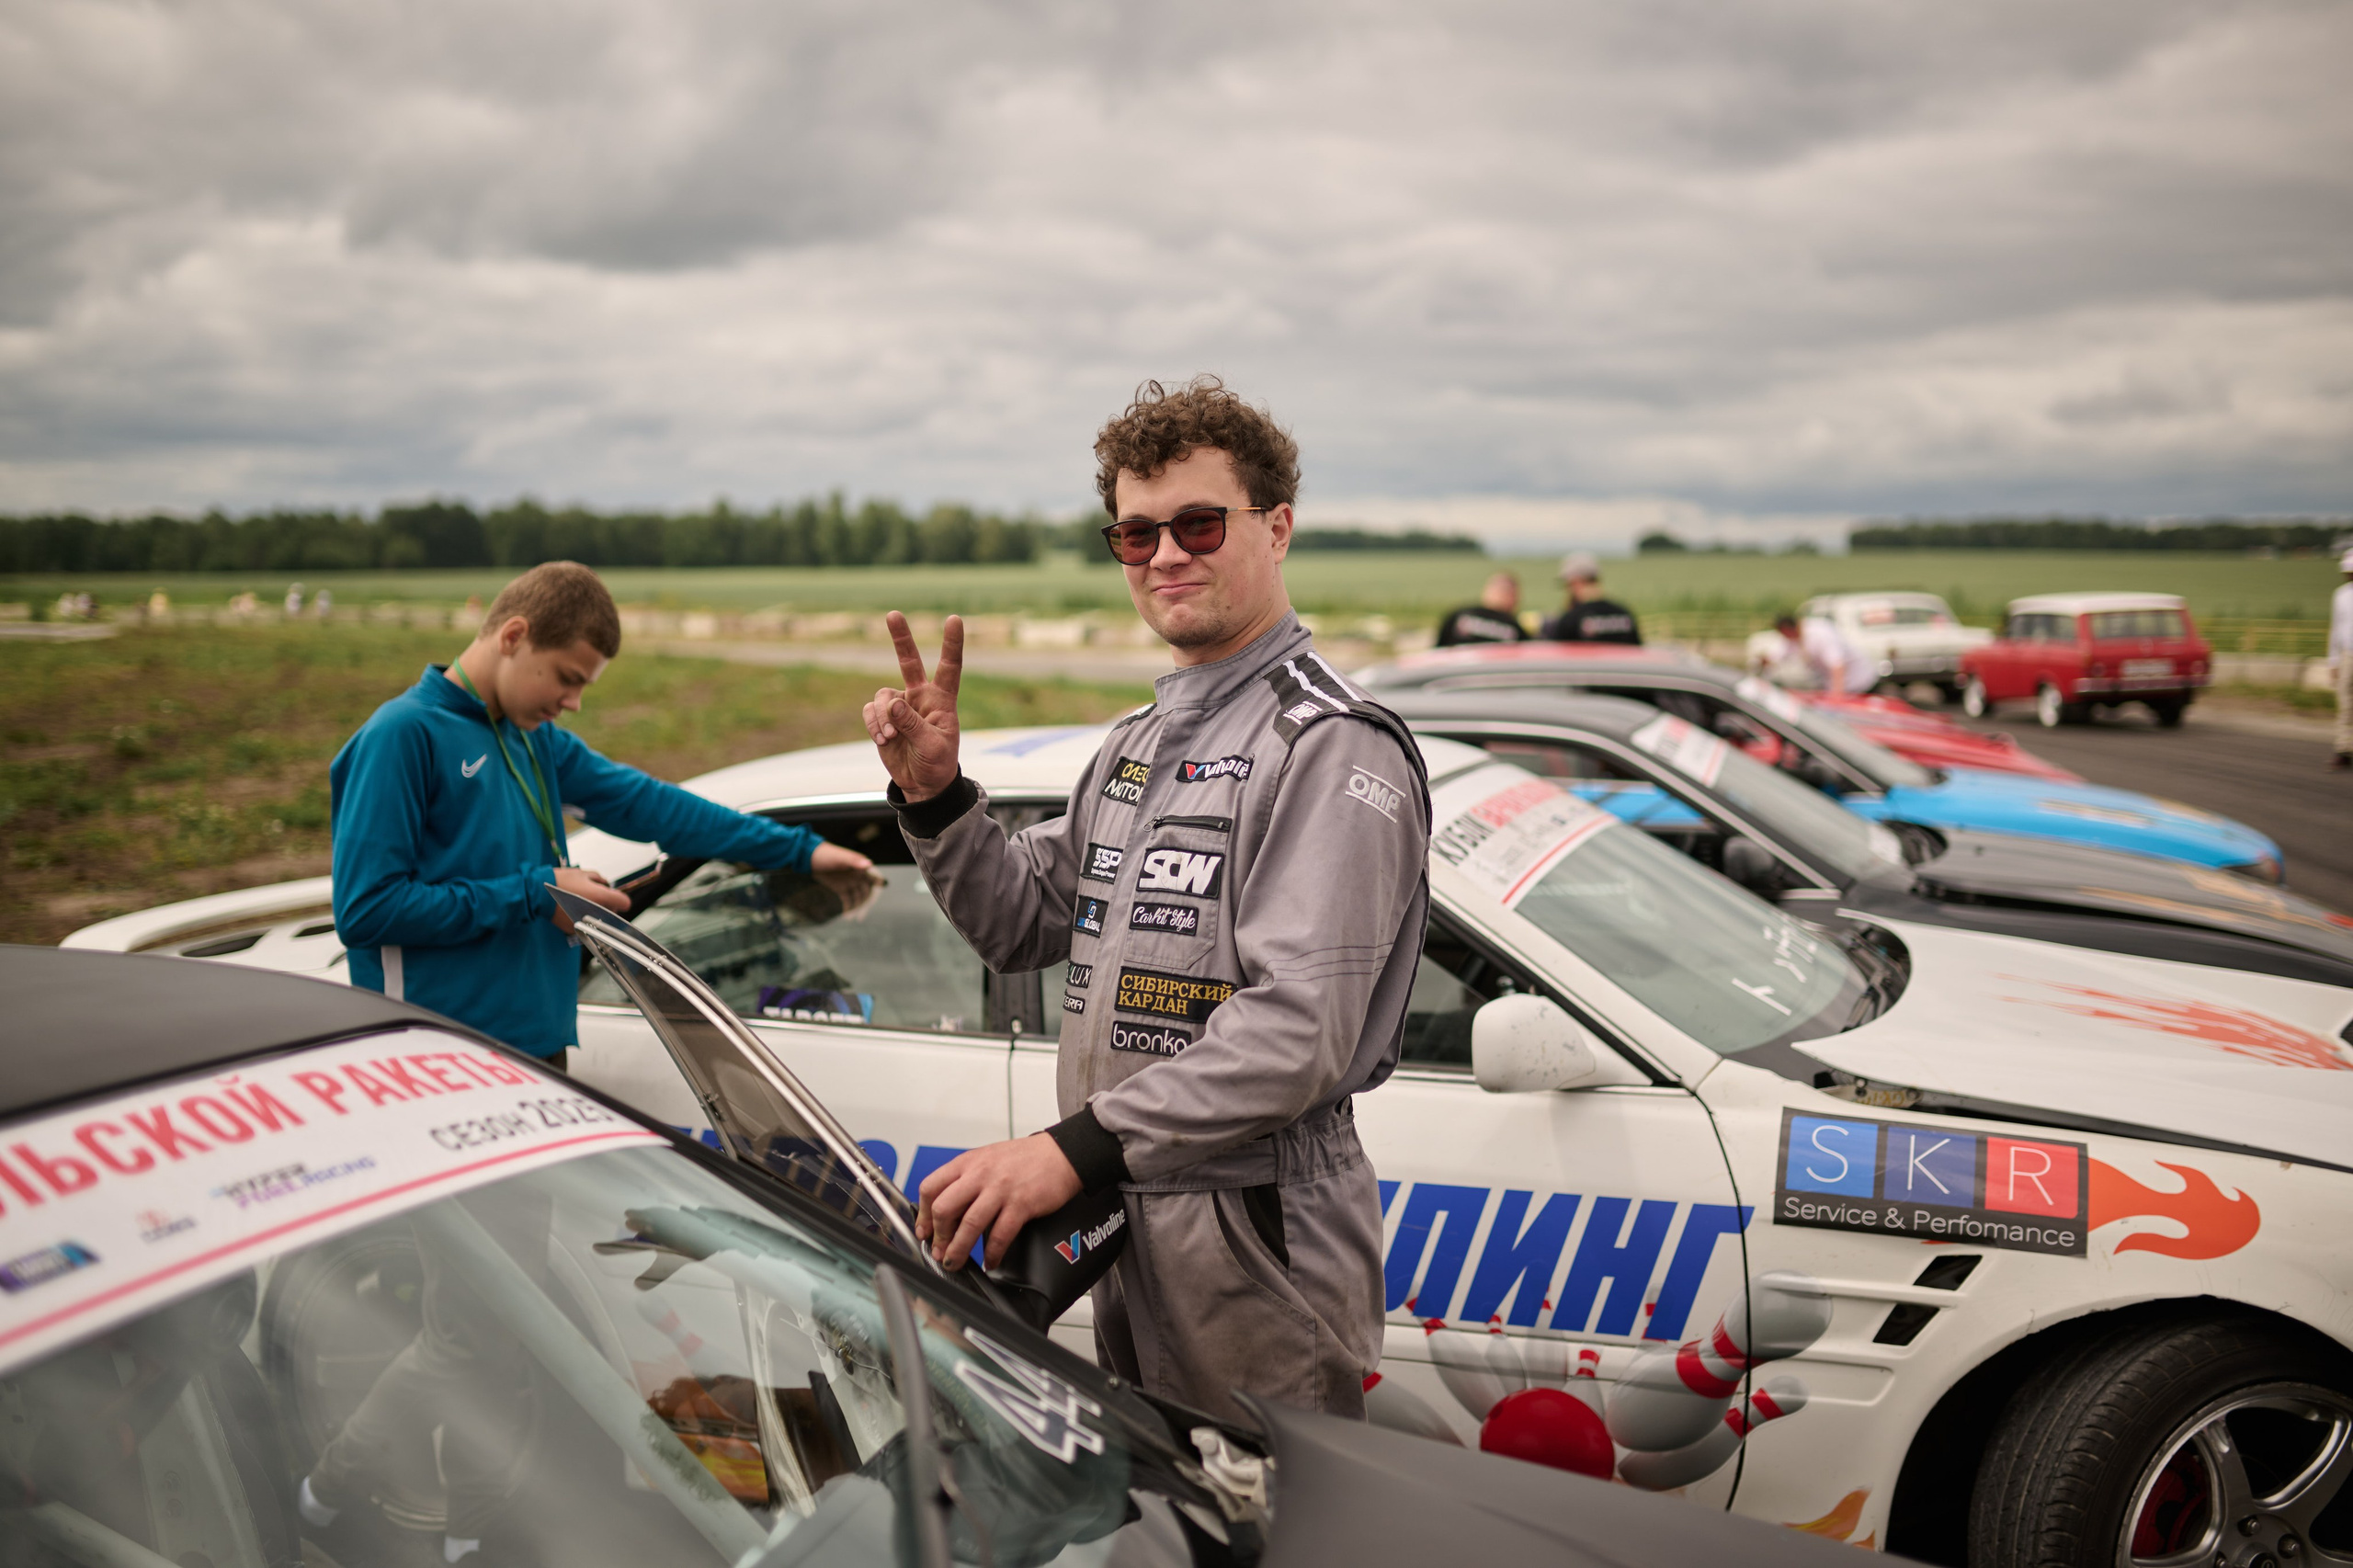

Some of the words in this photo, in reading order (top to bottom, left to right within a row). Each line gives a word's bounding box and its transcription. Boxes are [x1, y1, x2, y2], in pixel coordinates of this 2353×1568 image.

[1349, 773, 1401, 812] OMP
[1093, 847, 1122, 869] SSP
[1139, 849, 1222, 895] SCW
[1169, 907, 1196, 932] Style
[1118, 990, 1188, 1015] КАРДАН
[1120, 974, 1233, 1003] СИБИРСКИЙ
[290, 1051, 541, 1116] РАКЕТЫ
[429, 1113, 538, 1151] СЕЗОН
[1082, 1209, 1126, 1251] Valvoline
[1783, 1197, 1878, 1226] Service
[1884, 1207, 1906, 1230] &
[1914, 1209, 2075, 1247] Perfomance
